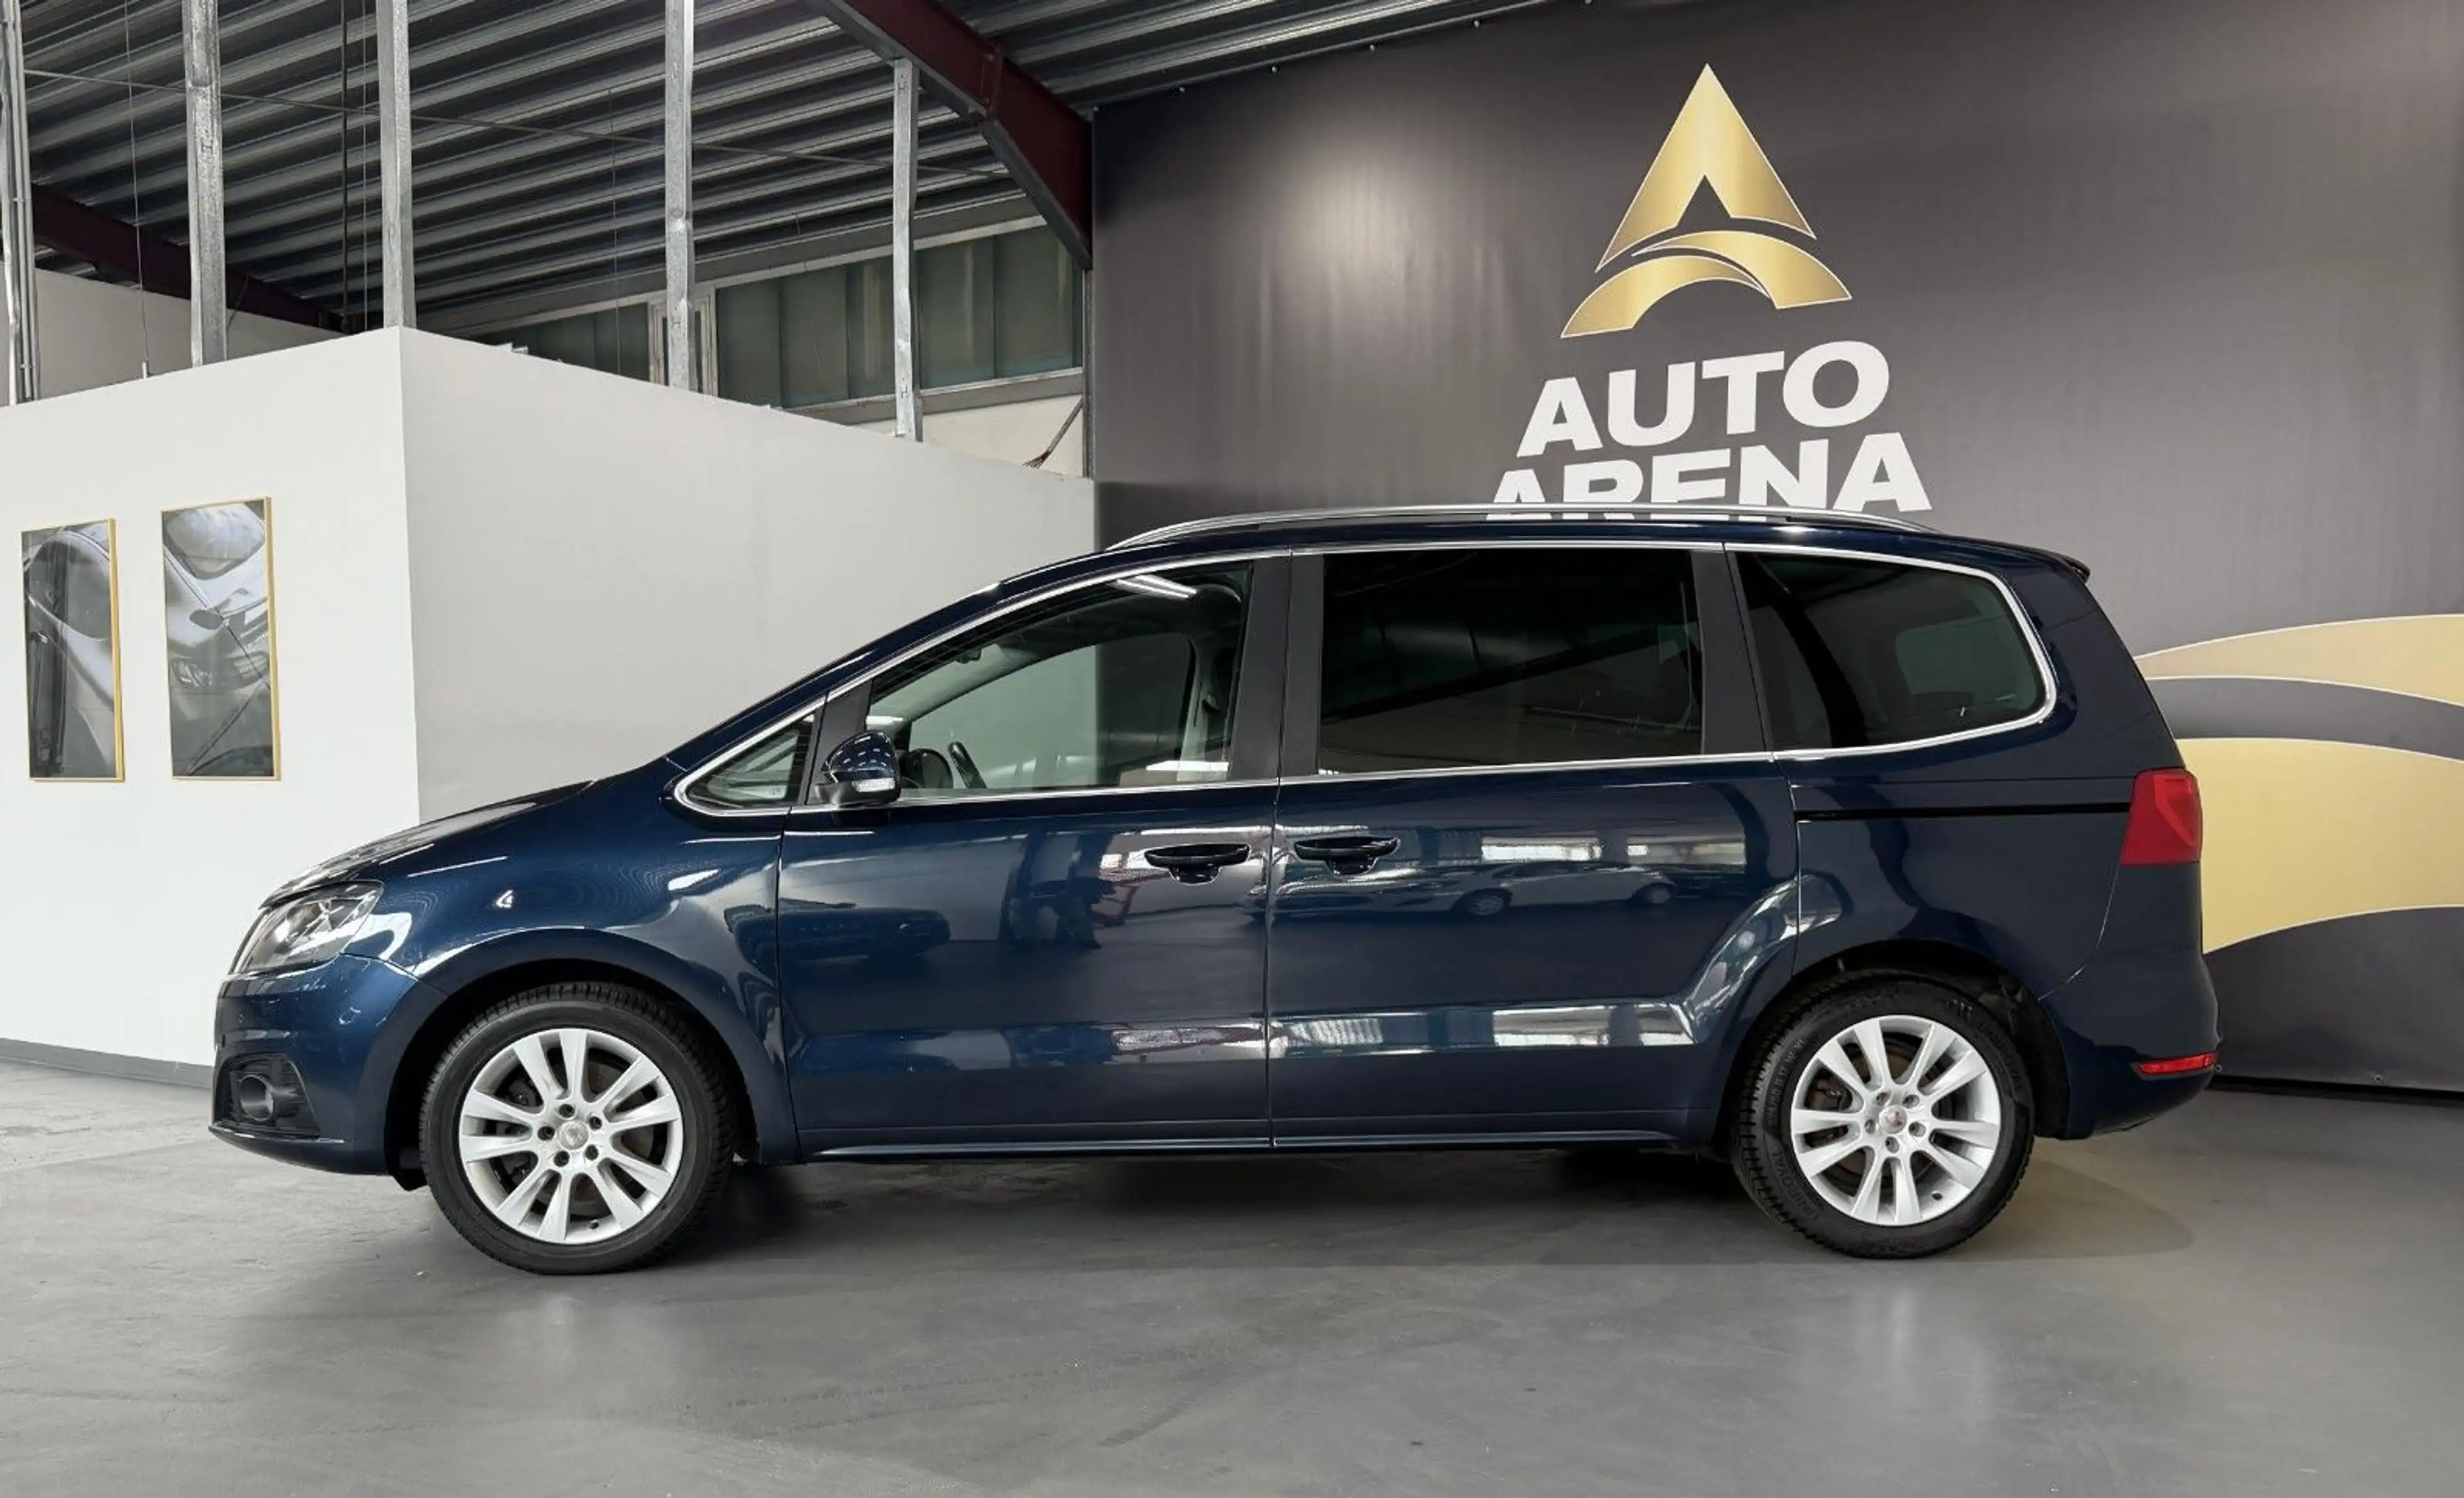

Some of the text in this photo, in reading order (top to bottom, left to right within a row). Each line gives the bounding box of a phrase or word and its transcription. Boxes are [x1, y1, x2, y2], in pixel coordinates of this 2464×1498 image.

[1516, 341, 1889, 457] AUTO
[1486, 432, 1932, 521] ARENA
[1771, 1152, 1820, 1221] UNIROYAL
